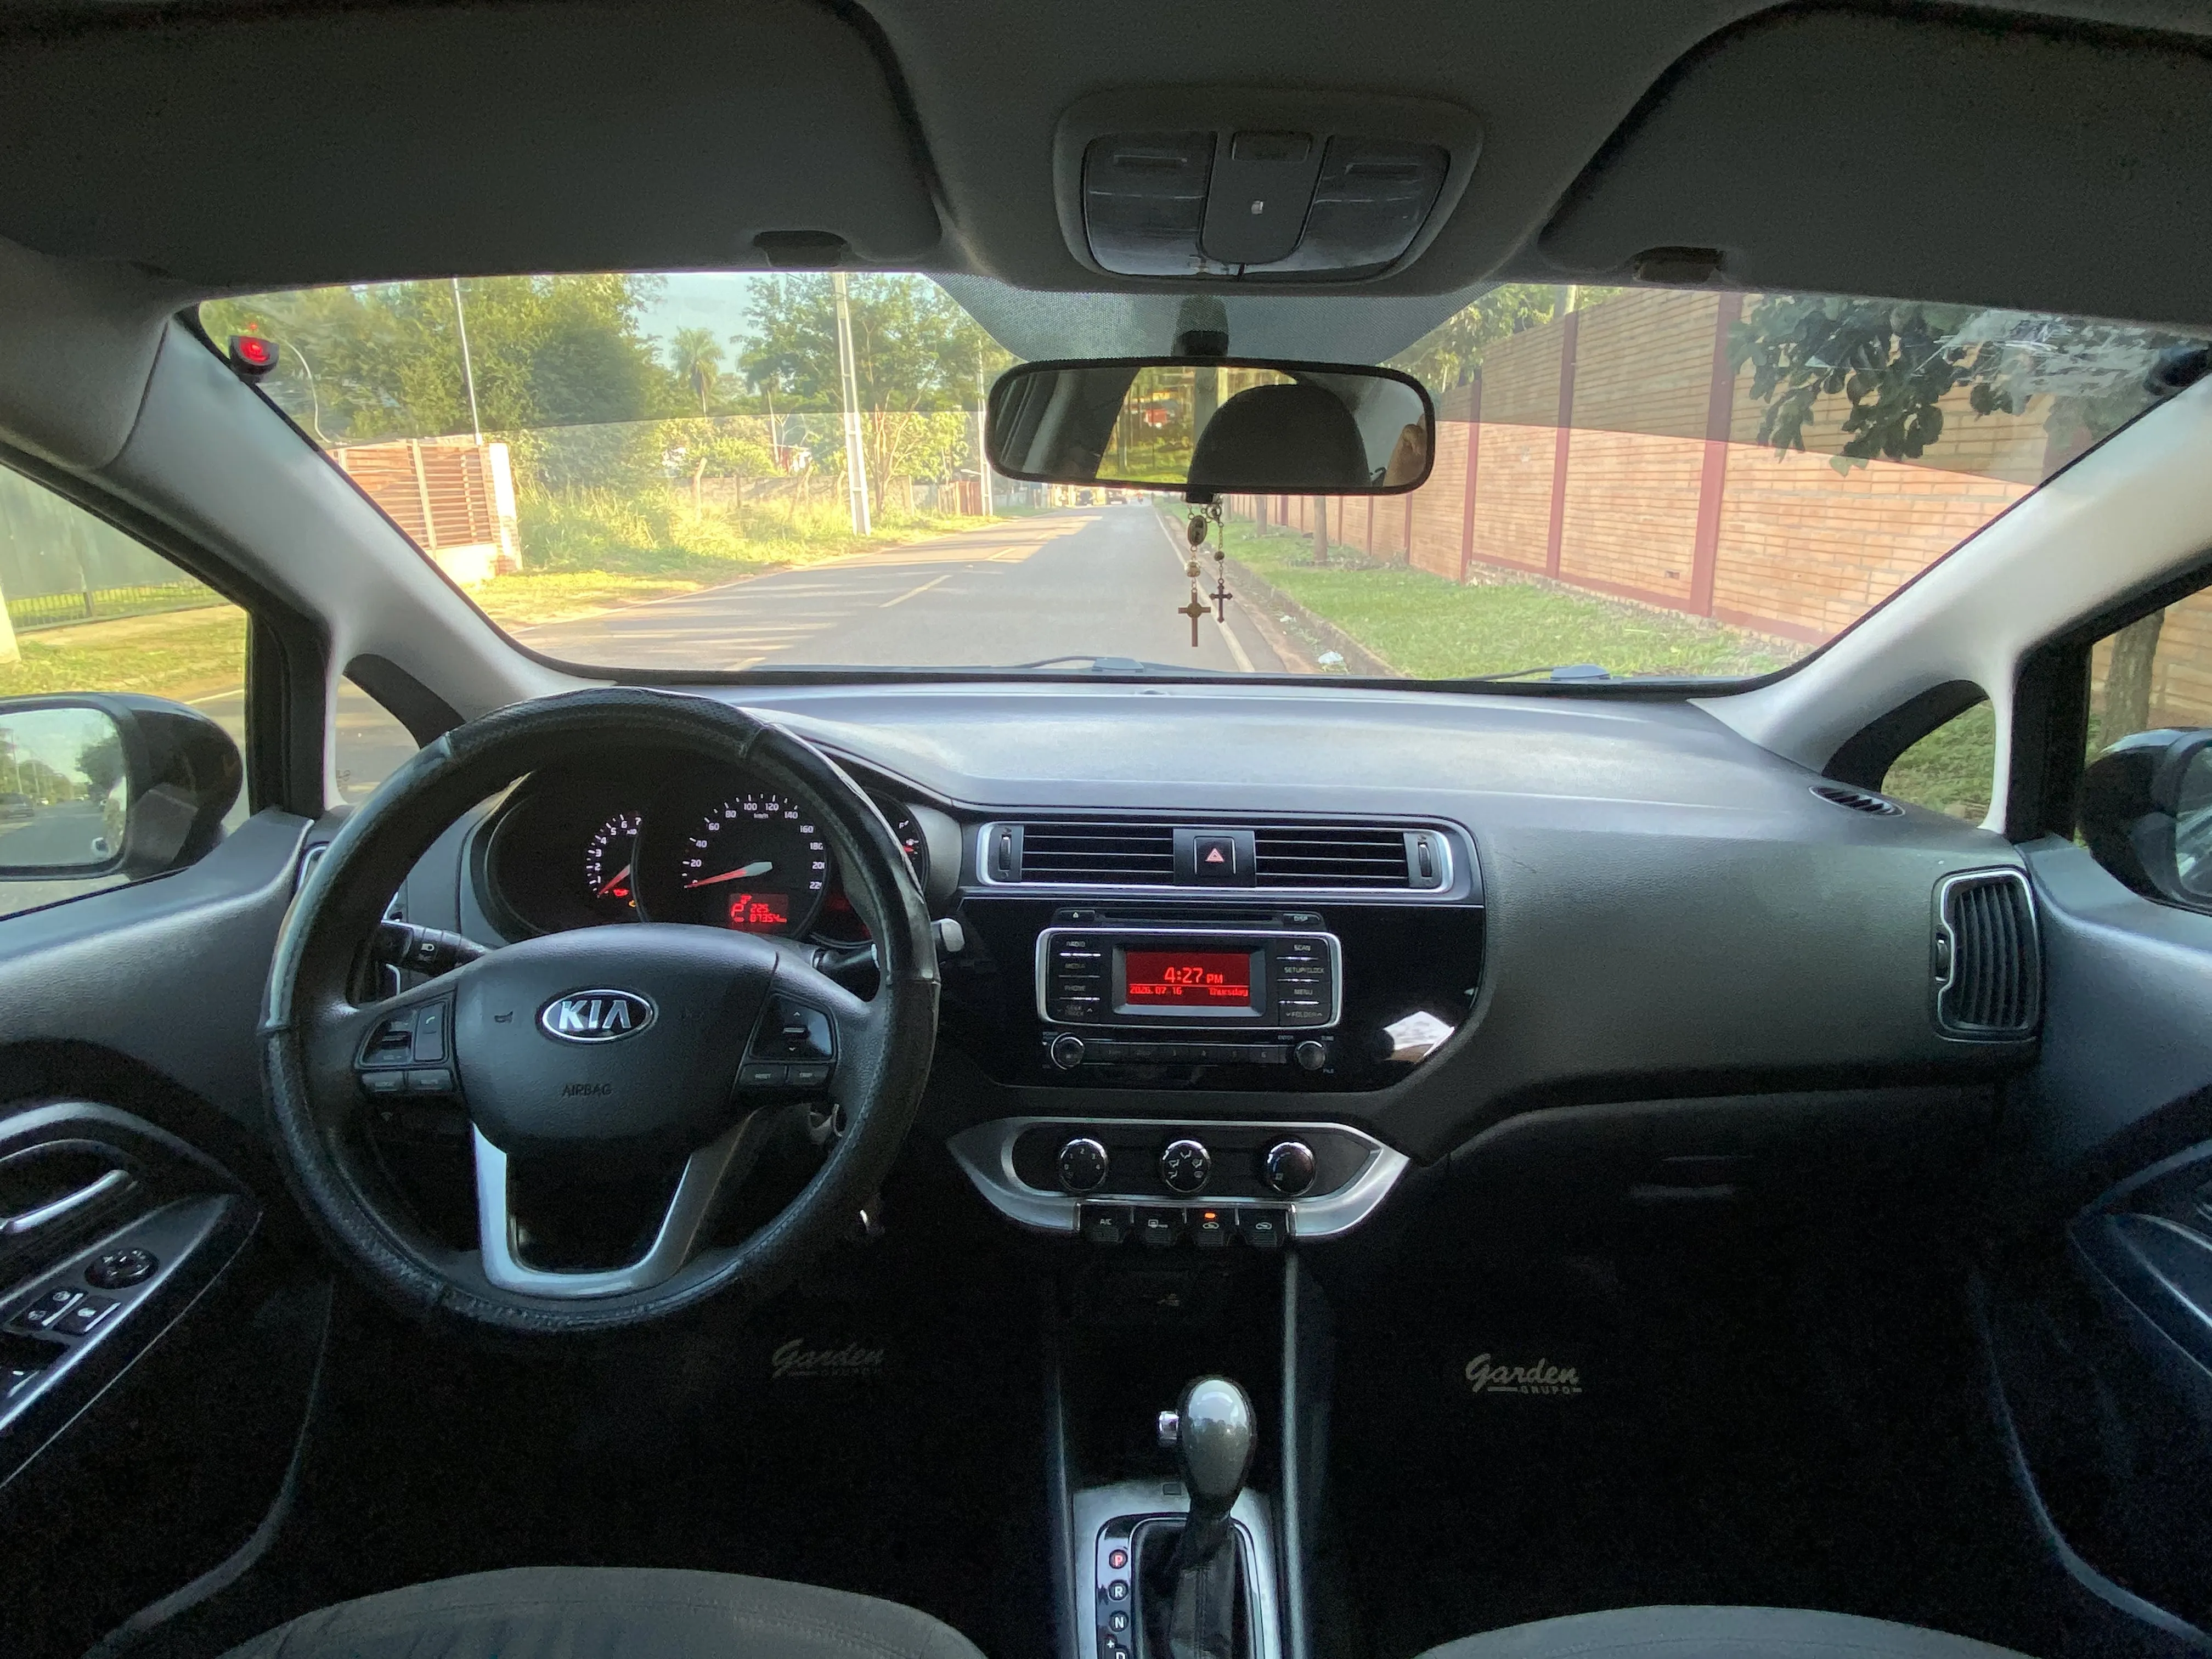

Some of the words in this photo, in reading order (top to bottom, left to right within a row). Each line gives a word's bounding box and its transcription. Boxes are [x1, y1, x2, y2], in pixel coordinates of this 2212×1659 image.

[743, 803, 758, 811] 100
[765, 803, 779, 811] 120
[784, 811, 798, 819] 140
[635, 817, 642, 826] 7
[610, 827, 617, 836] 5
[799, 825, 814, 833] 160
[600, 837, 607, 845] 4
[595, 849, 602, 857] 3
[594, 862, 601, 871] 2
[690, 859, 702, 867] 20
[1164, 967, 1203, 984] 4:27
[1206, 973, 1223, 984] PM
[1209, 987, 1248, 997] Thursday
[558, 1000, 632, 1030] KIA
[561, 1083, 613, 1098] AIRBAG
[1465, 1353, 1579, 1393] Garden
[1114, 1555, 1124, 1567] P
[1114, 1585, 1124, 1598] R
[1114, 1616, 1124, 1629] N
